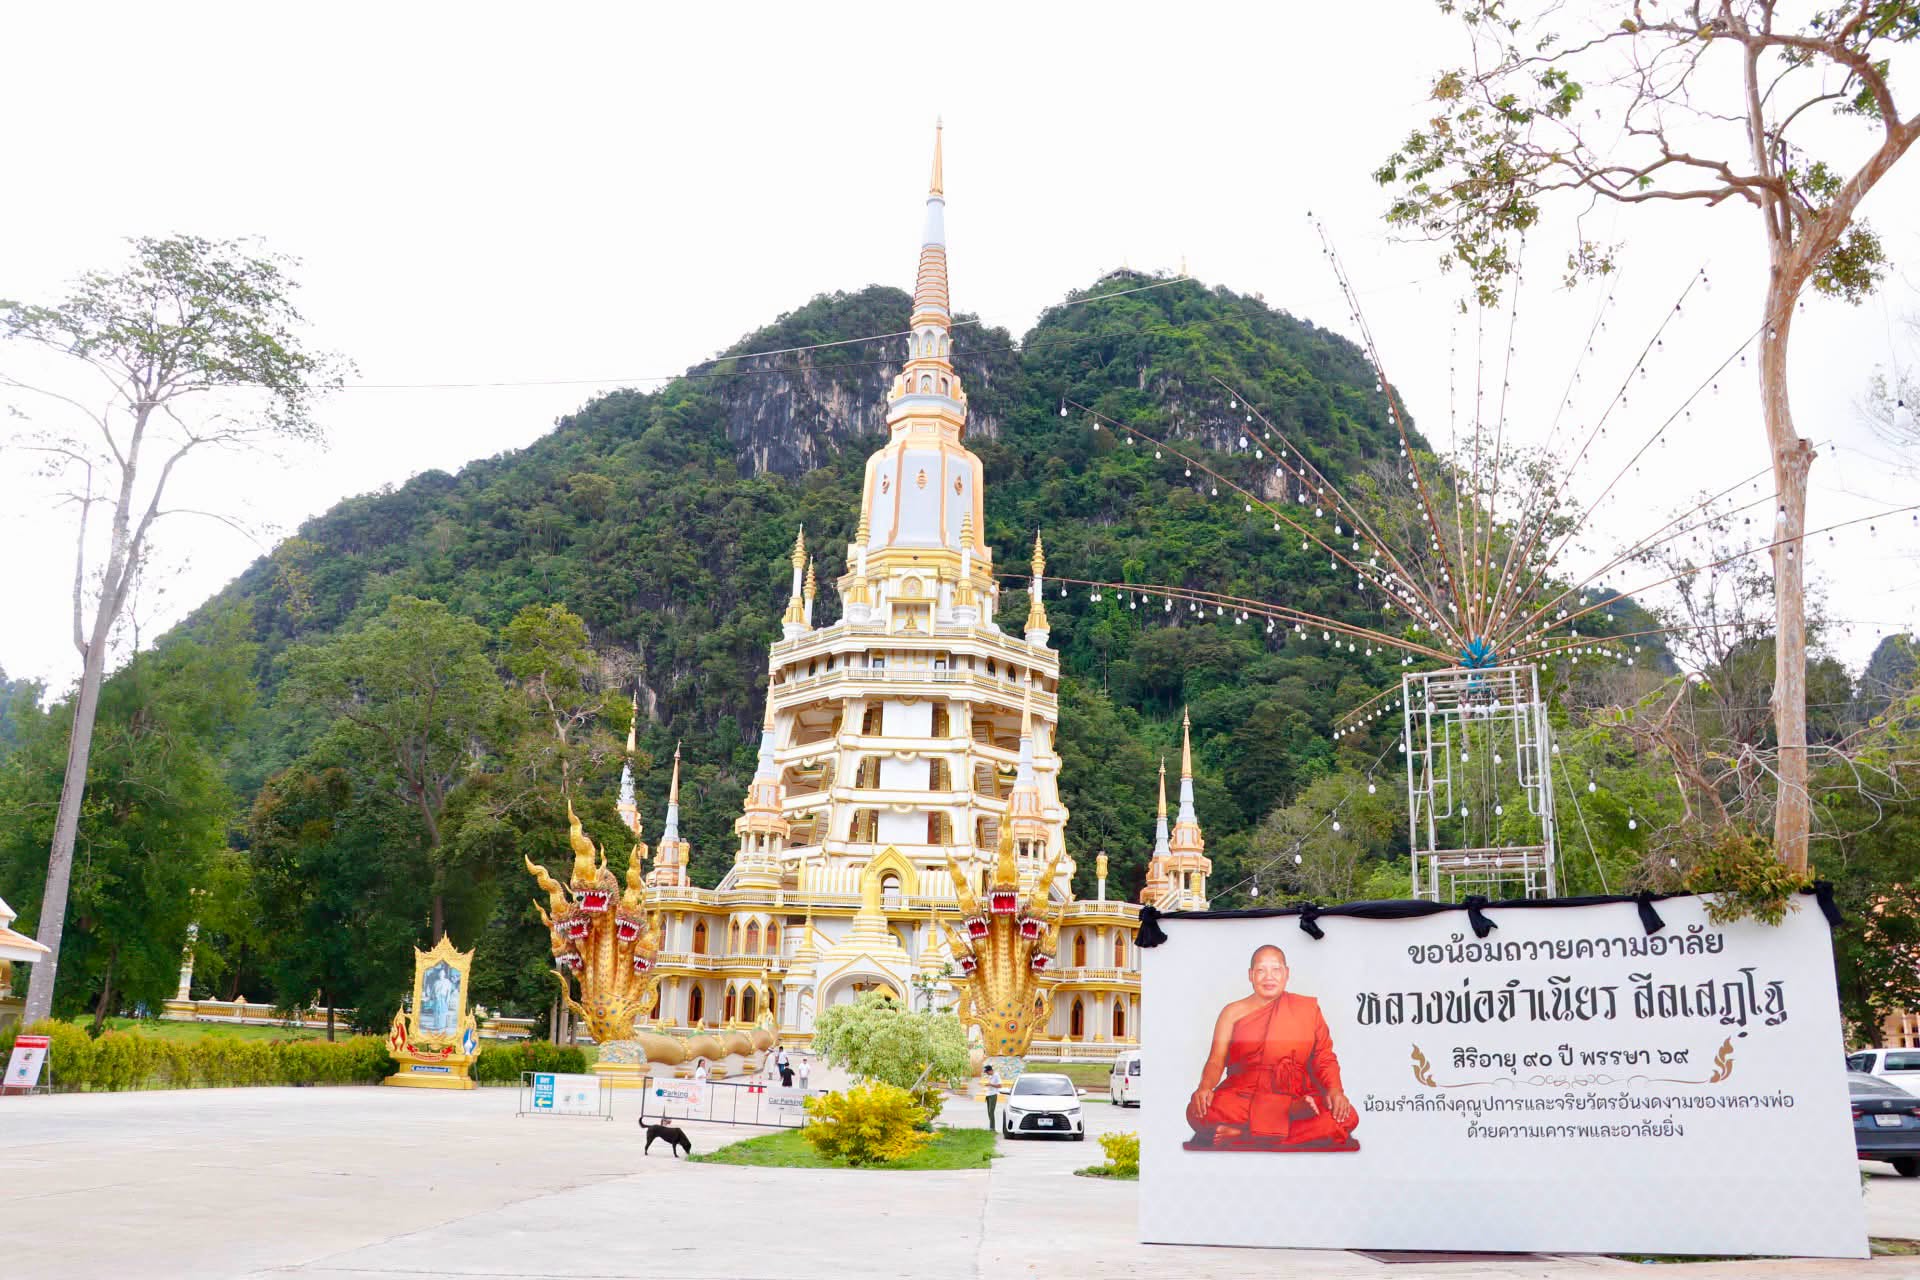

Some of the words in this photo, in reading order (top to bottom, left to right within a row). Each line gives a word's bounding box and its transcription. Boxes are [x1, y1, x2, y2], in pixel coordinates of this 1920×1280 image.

[1407, 924, 1724, 965] ขอน้อมถวายความอาลัย
[1356, 975, 1619, 1026] หลวงพ่อจำเนียร
[1452, 1046, 1517, 1076] สิริอายุ
[1523, 1050, 1553, 1067] ๙๐
[1557, 1043, 1574, 1067] ปี
[1579, 1049, 1651, 1066] พรรษา
[1656, 1048, 1690, 1065] ๖๙
[663, 1089, 688, 1098] Parking
[1363, 1090, 1795, 1118] น้อมรำลึกถึงคุณูปการและจริยวัตรอันงดงามของหลวงพ่อ
[1466, 1115, 1685, 1139] ด้วยความเคารพและอาลัยยิ่ง
